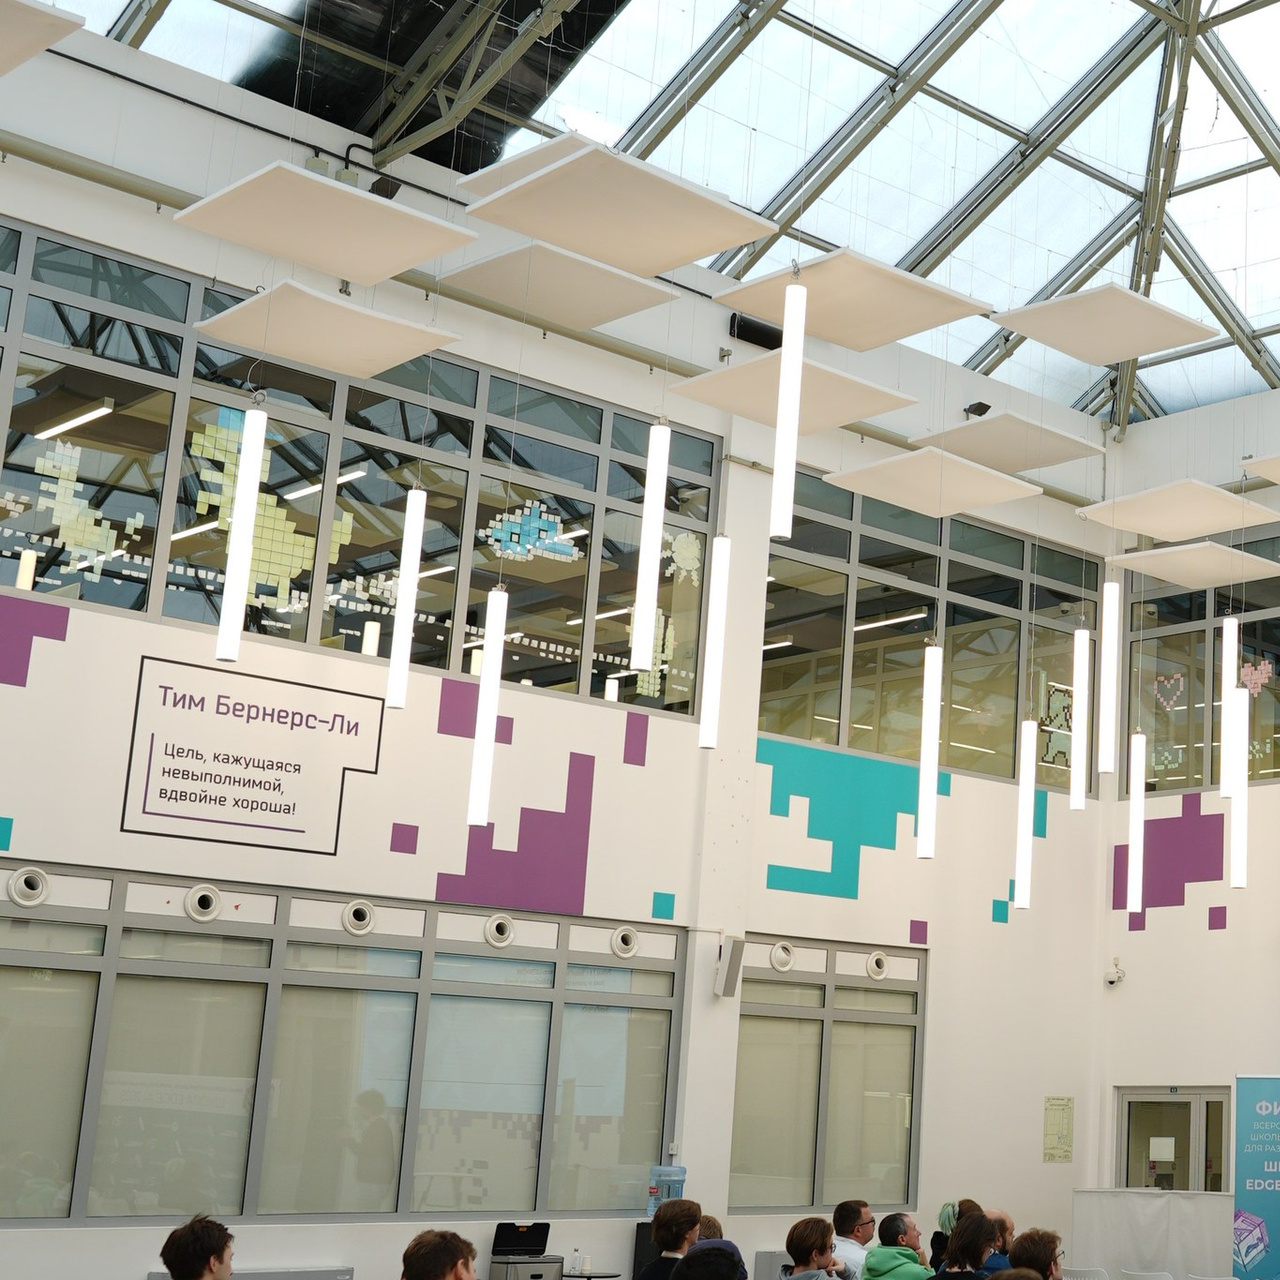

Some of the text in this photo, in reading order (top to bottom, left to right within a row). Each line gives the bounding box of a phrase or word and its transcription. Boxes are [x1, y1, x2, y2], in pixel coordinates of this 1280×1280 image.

[158, 684, 360, 737] Тим Бернерс-Ли
[164, 742, 302, 775] Цель, кажущаяся
[161, 766, 285, 796] невыполнимой,
[158, 787, 297, 816] вдвойне хороша!
[1244, 1144, 1263, 1153] ДЛЯ
